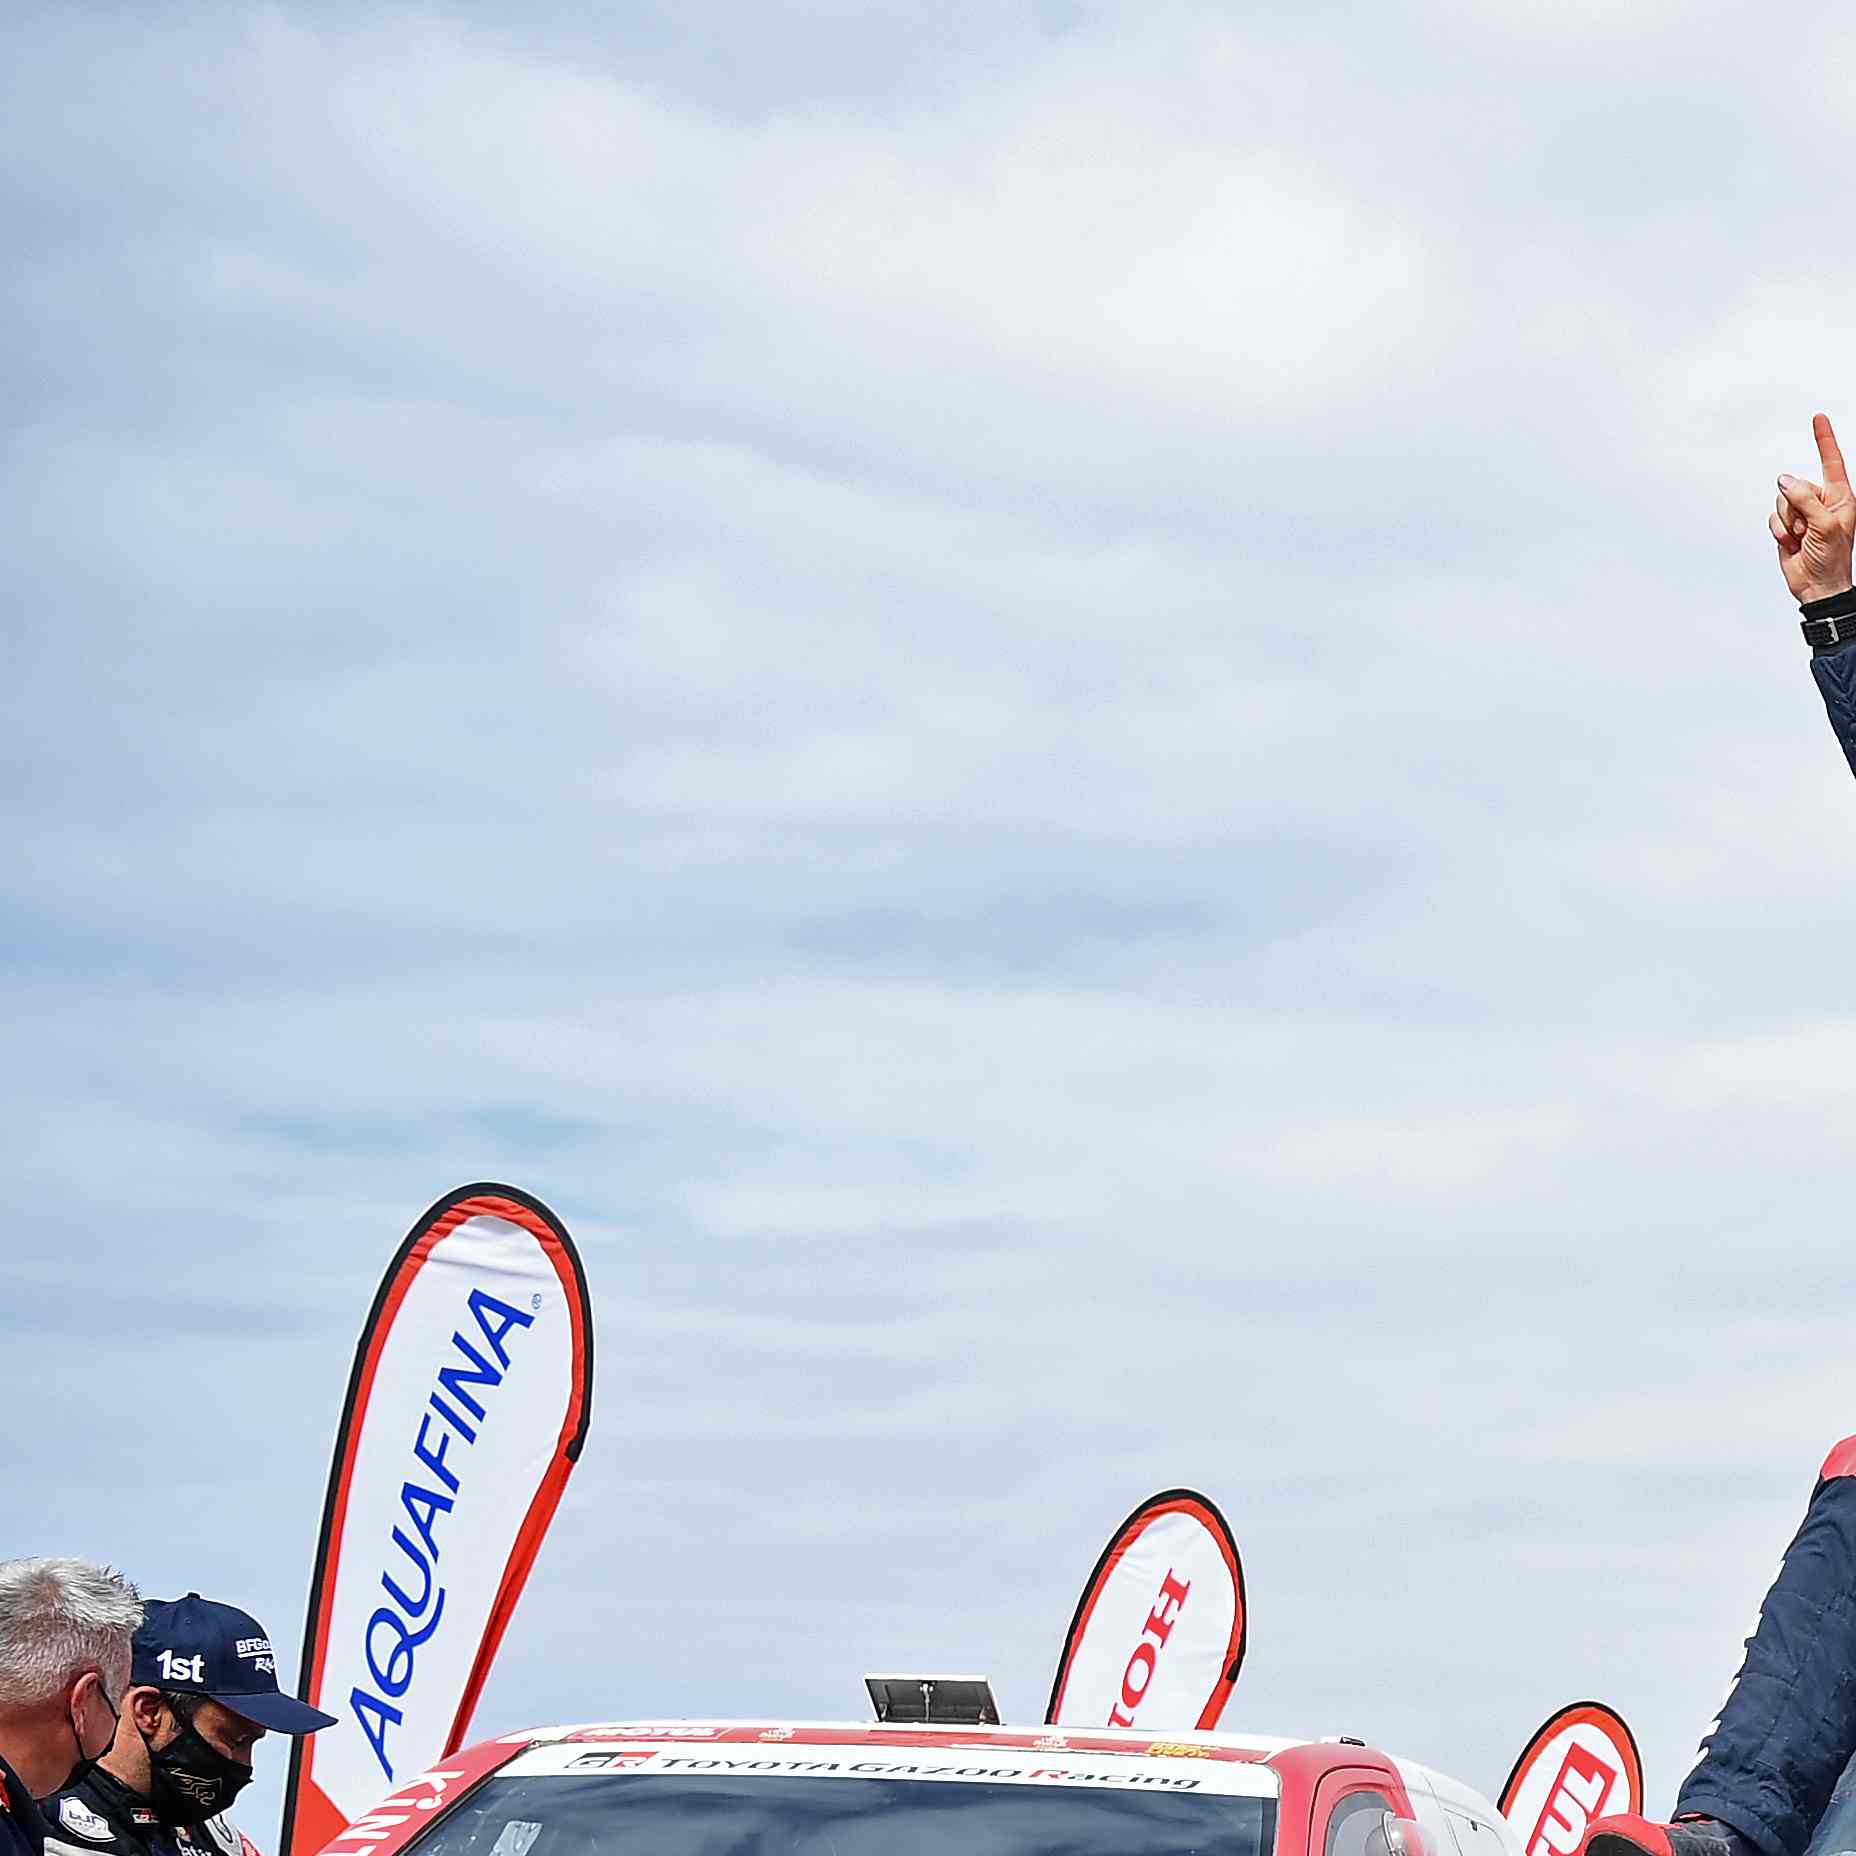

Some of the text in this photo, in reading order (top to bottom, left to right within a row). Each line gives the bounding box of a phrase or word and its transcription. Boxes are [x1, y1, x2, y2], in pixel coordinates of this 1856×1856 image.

[350, 1287, 536, 1784] AQUAFINA
[156, 1649, 206, 1684] 1st
[659, 1757, 841, 1772] TOYOTA
[849, 1762, 1022, 1778] GAZOO
[1027, 1768, 1201, 1790] Racing
